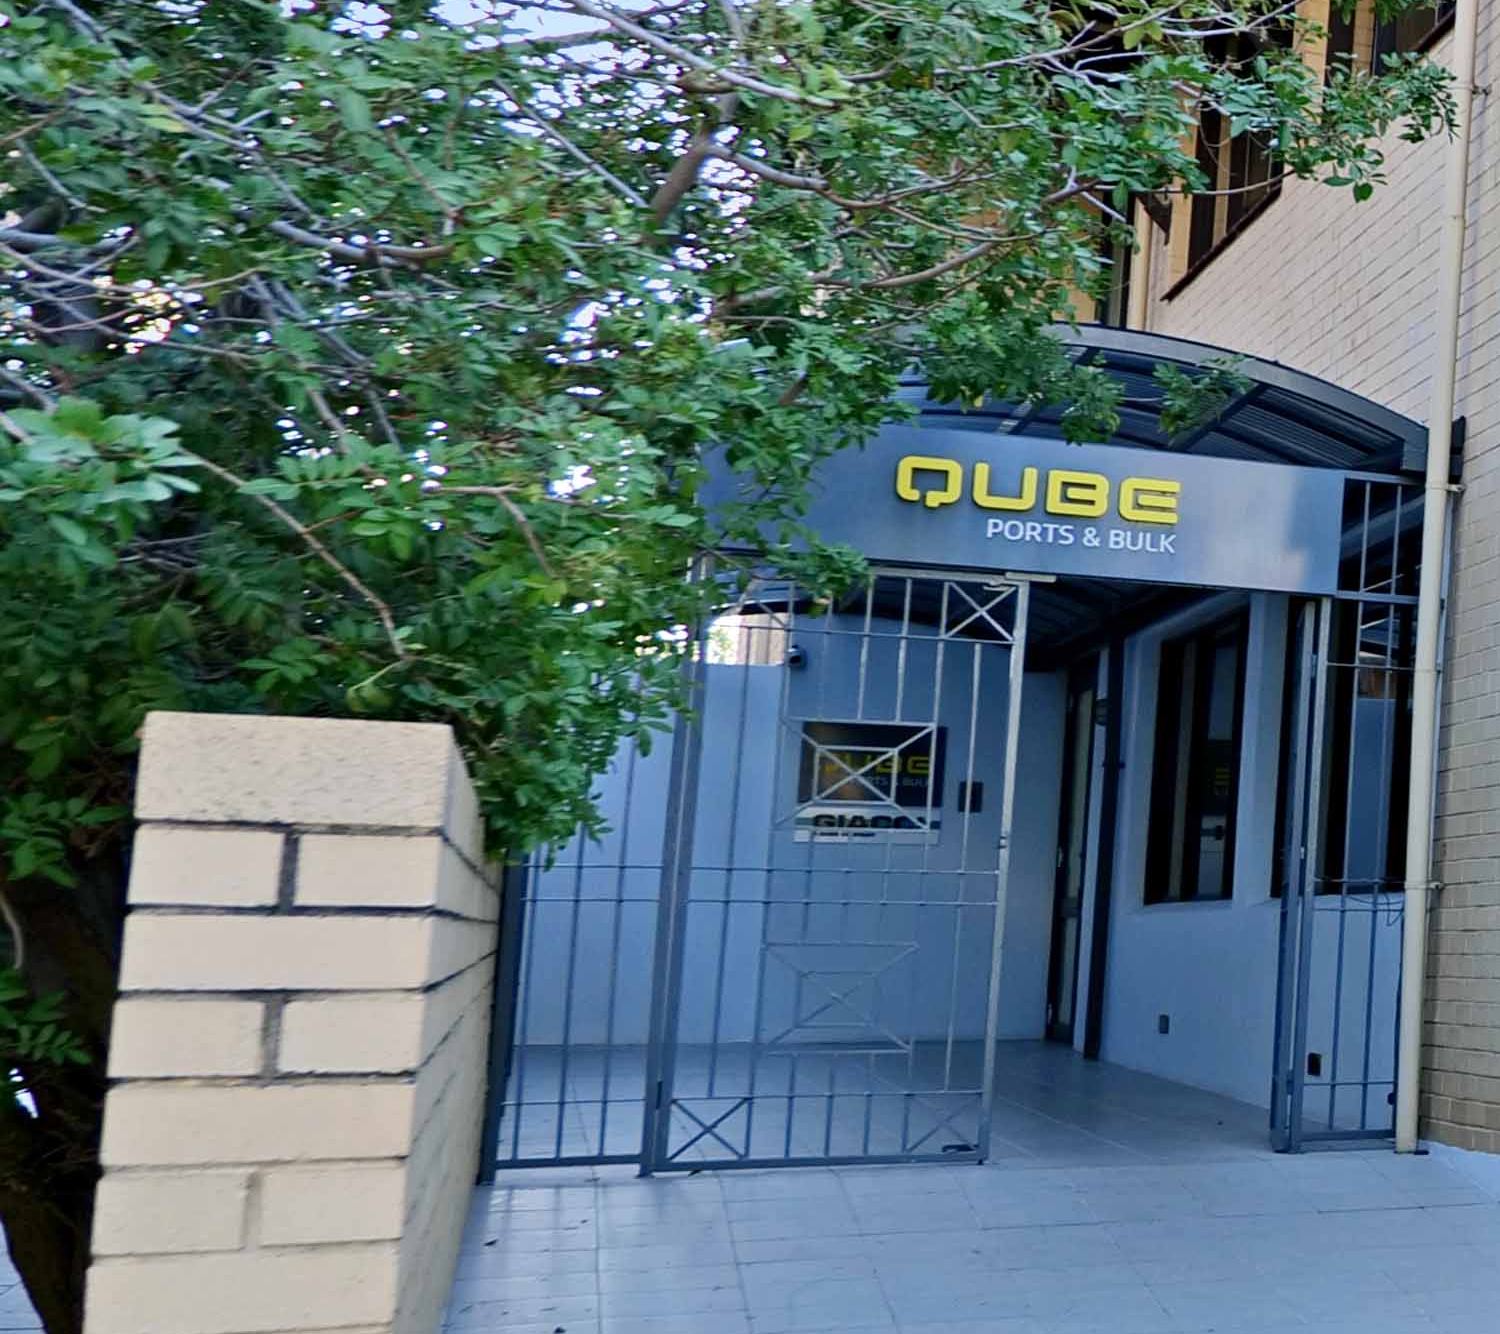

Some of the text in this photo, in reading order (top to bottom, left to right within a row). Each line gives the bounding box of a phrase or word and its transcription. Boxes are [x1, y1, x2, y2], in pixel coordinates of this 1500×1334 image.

[896, 455, 1181, 525] QUBE
[986, 518, 1177, 554] PORTS & BULK
